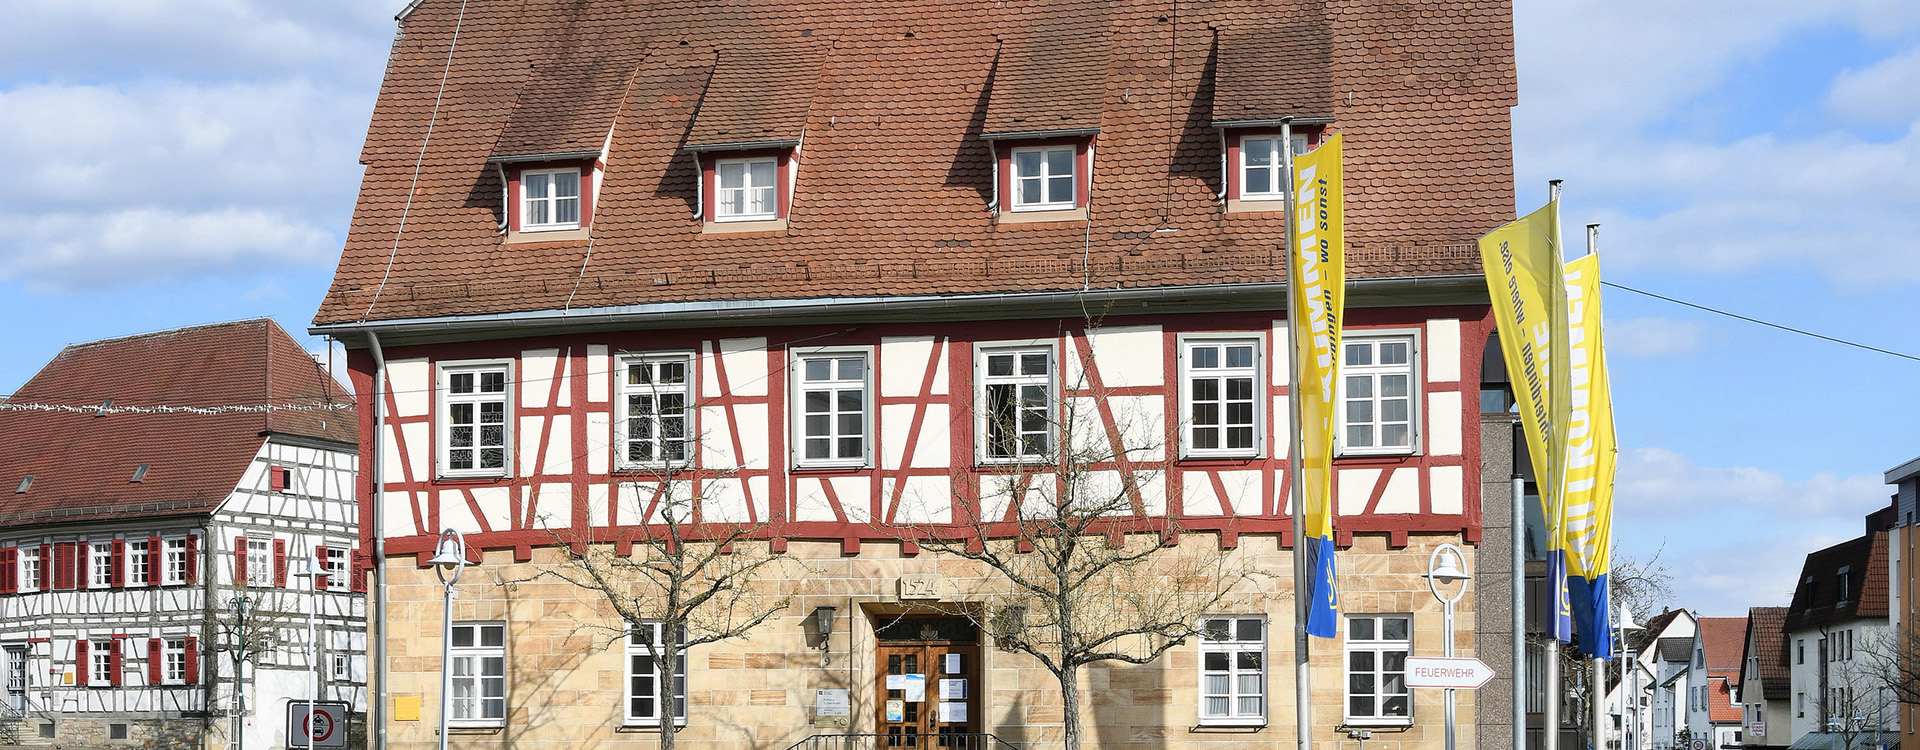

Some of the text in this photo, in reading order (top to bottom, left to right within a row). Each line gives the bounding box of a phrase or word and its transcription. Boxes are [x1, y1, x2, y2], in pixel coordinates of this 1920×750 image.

[1318, 174, 1328, 231] sonst.
[1320, 239, 1329, 263] wo
[903, 579, 938, 596] 1524
[1415, 667, 1475, 678] FEUERWEHR
